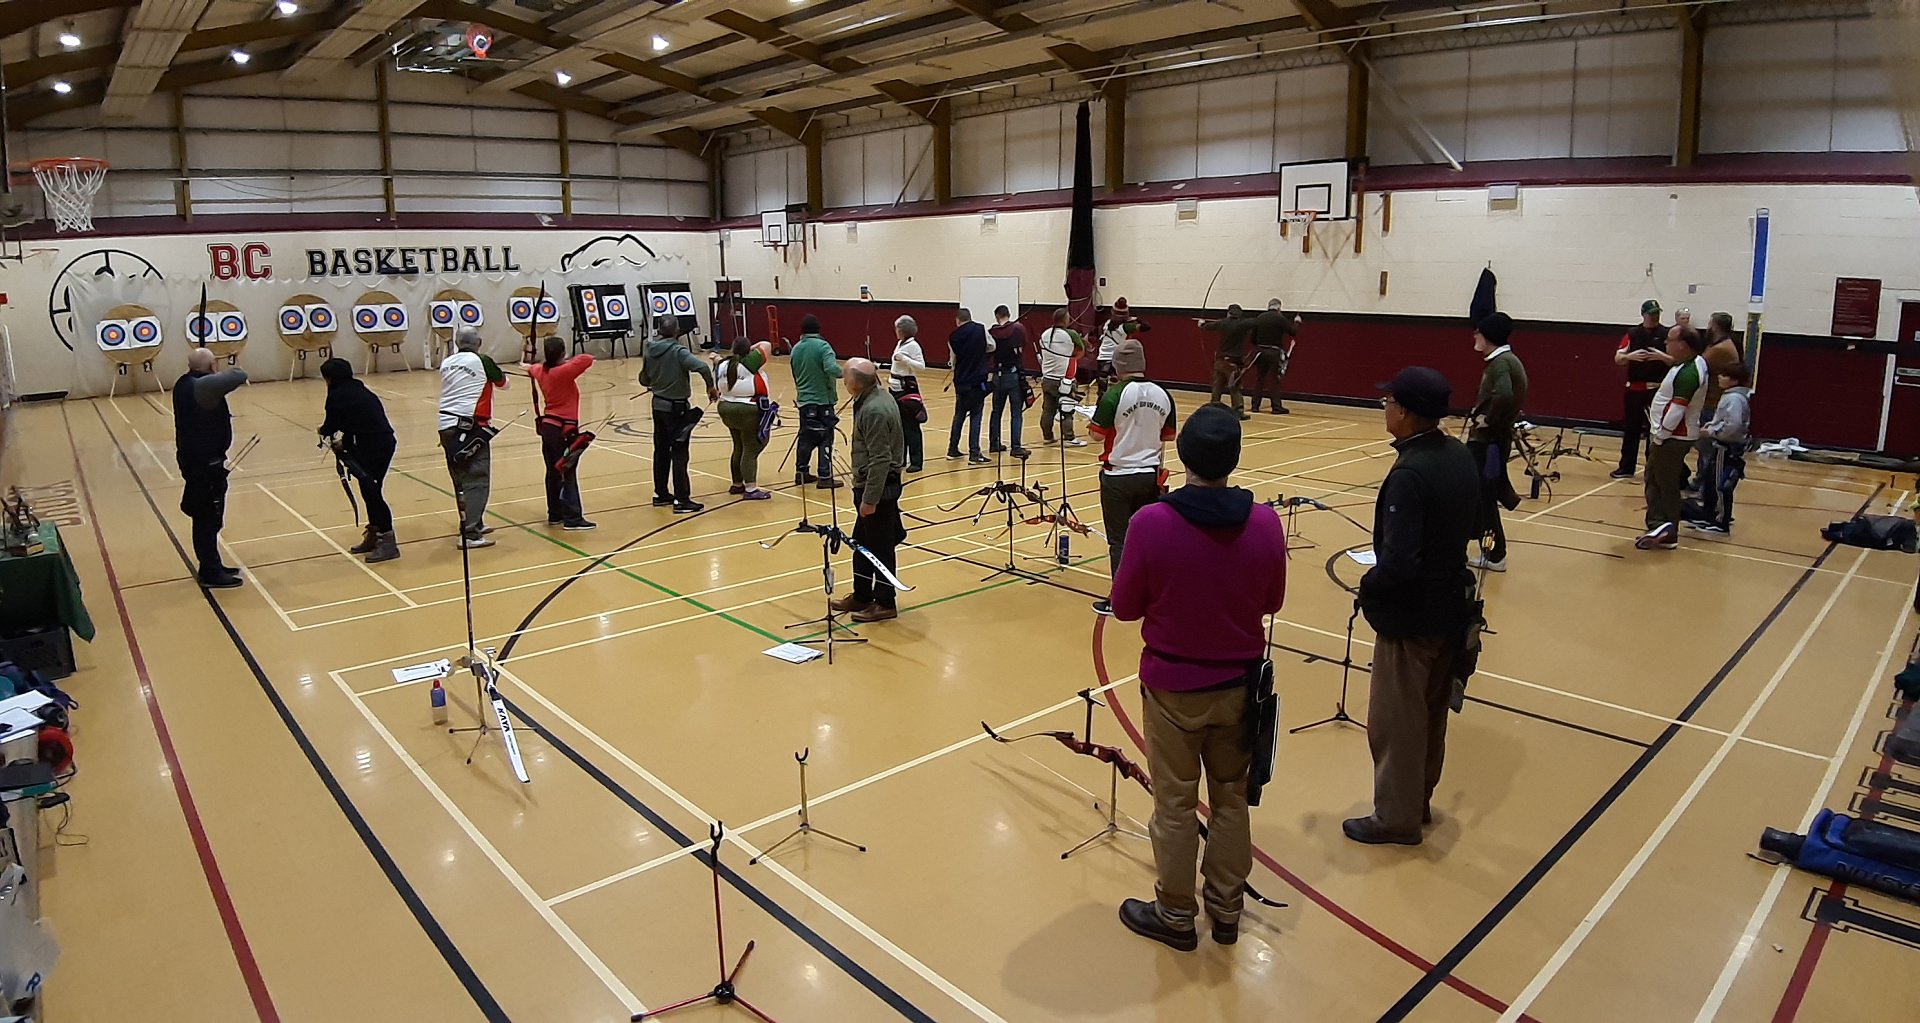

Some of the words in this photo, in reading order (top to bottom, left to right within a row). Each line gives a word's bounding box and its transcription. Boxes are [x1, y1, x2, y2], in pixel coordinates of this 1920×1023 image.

[208, 243, 272, 280] BC
[306, 246, 520, 276] BASKETBALL
[497, 708, 510, 733] KAYA
